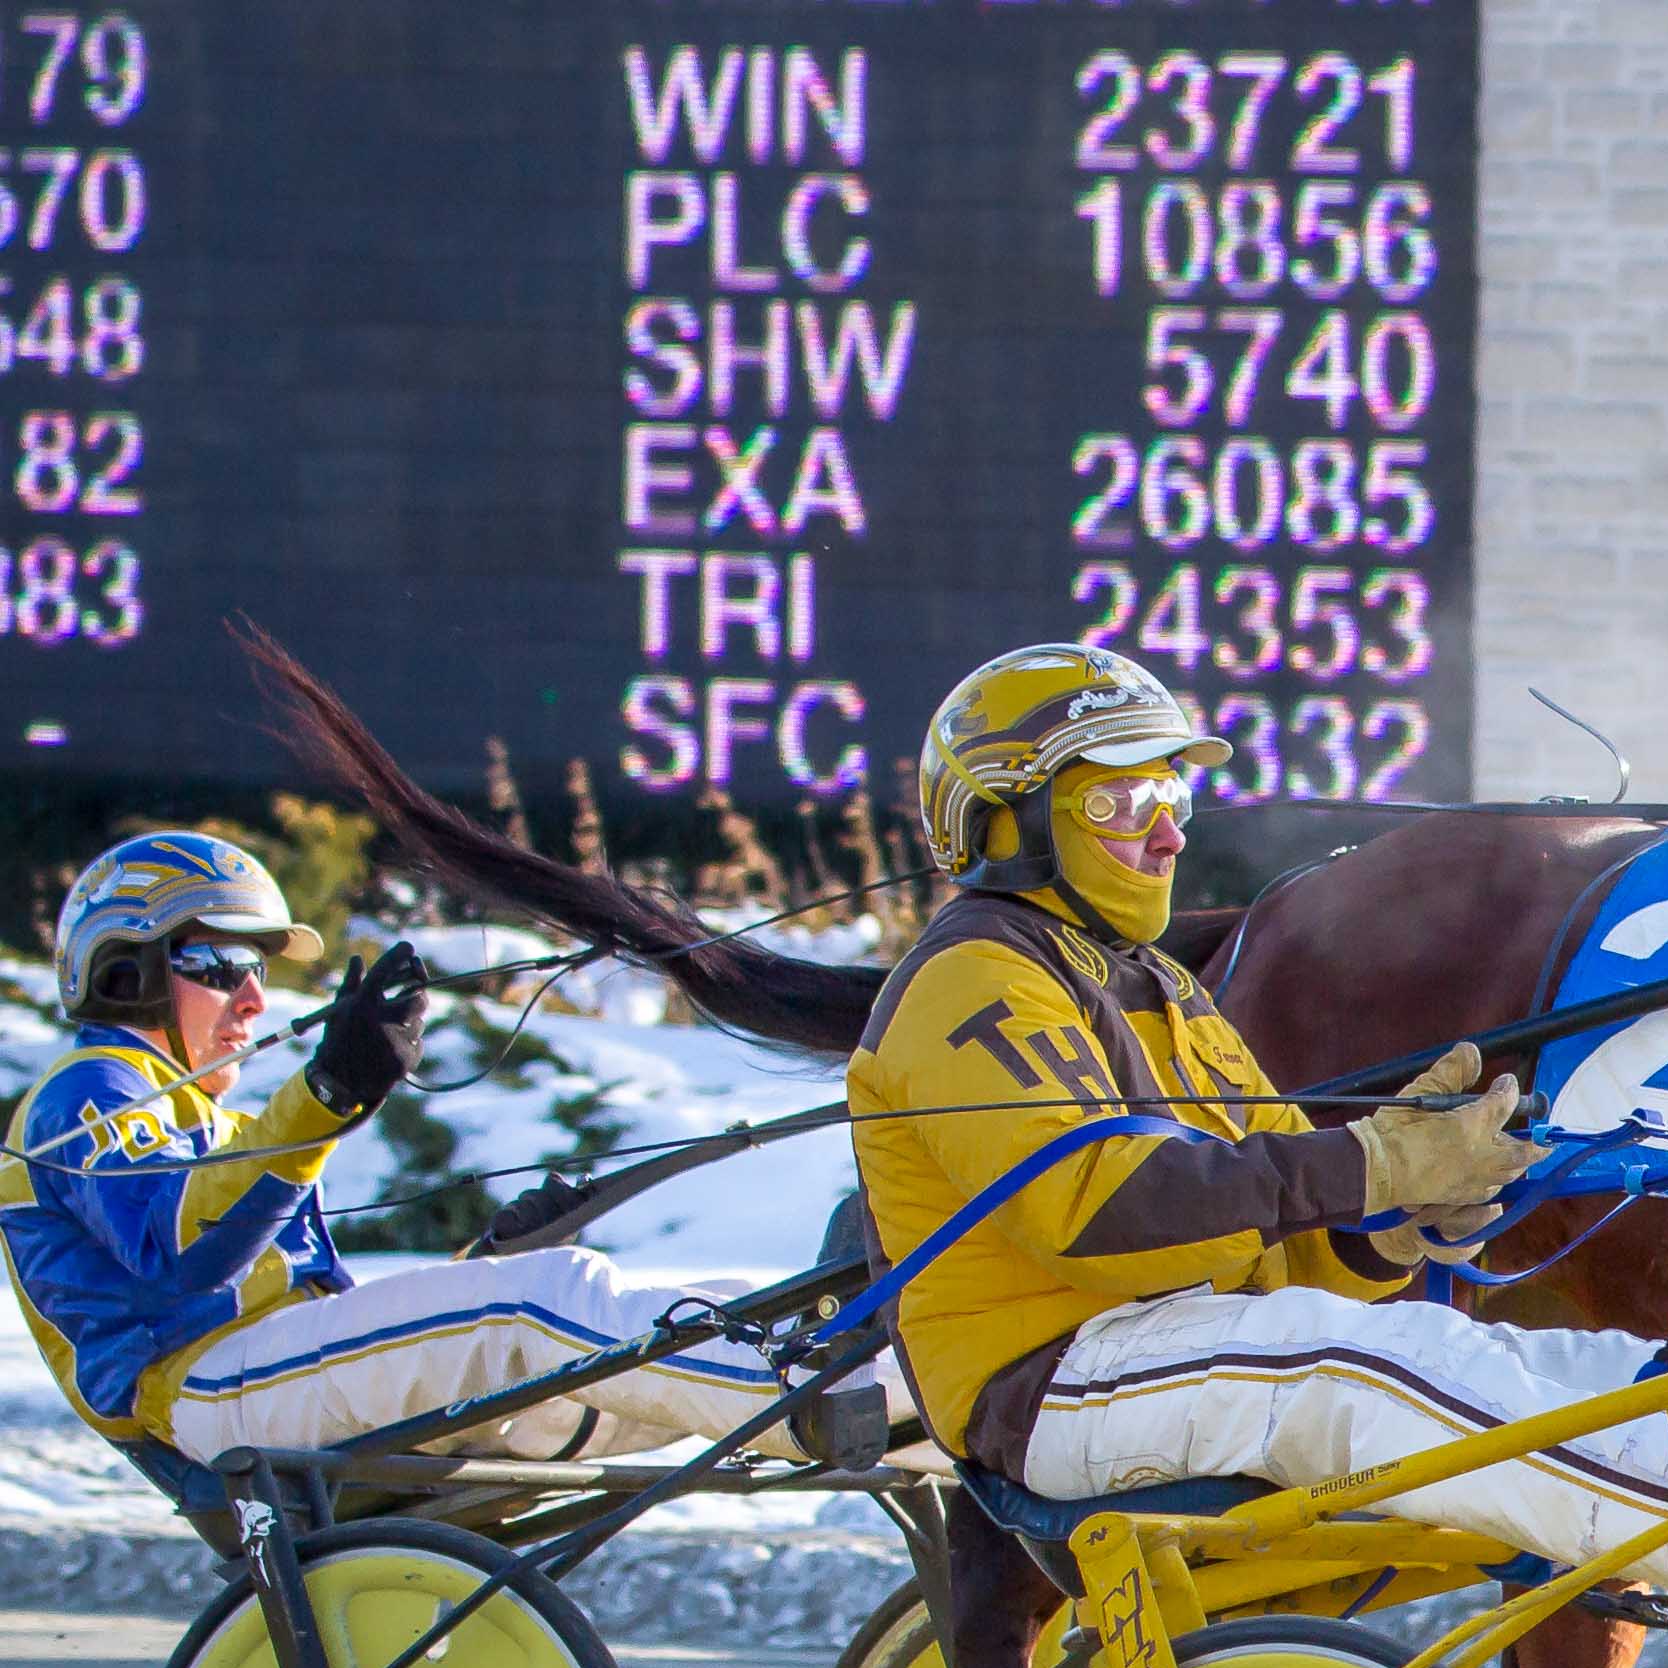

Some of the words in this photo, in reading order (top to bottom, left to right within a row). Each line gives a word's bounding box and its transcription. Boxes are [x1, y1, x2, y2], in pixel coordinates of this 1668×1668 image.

[20, 14, 147, 125] 79
[622, 43, 868, 166] WIN
[1074, 49, 1415, 171] 23721
[0, 147, 146, 251] 70
[623, 170, 871, 292] PLC
[1074, 178, 1437, 301] 10856
[0, 274, 145, 382] 48
[623, 297, 916, 420] SHW
[1141, 306, 1436, 430] 5740
[14, 411, 143, 515] 82
[623, 423, 867, 537] EXA
[1070, 433, 1436, 553] 26085
[0, 537, 144, 646] 83
[617, 549, 815, 661] TRI
[1070, 562, 1435, 684] 24353
[620, 673, 868, 794] SFC
[1174, 690, 1429, 803] 332
[946, 998, 1128, 1116] TH
